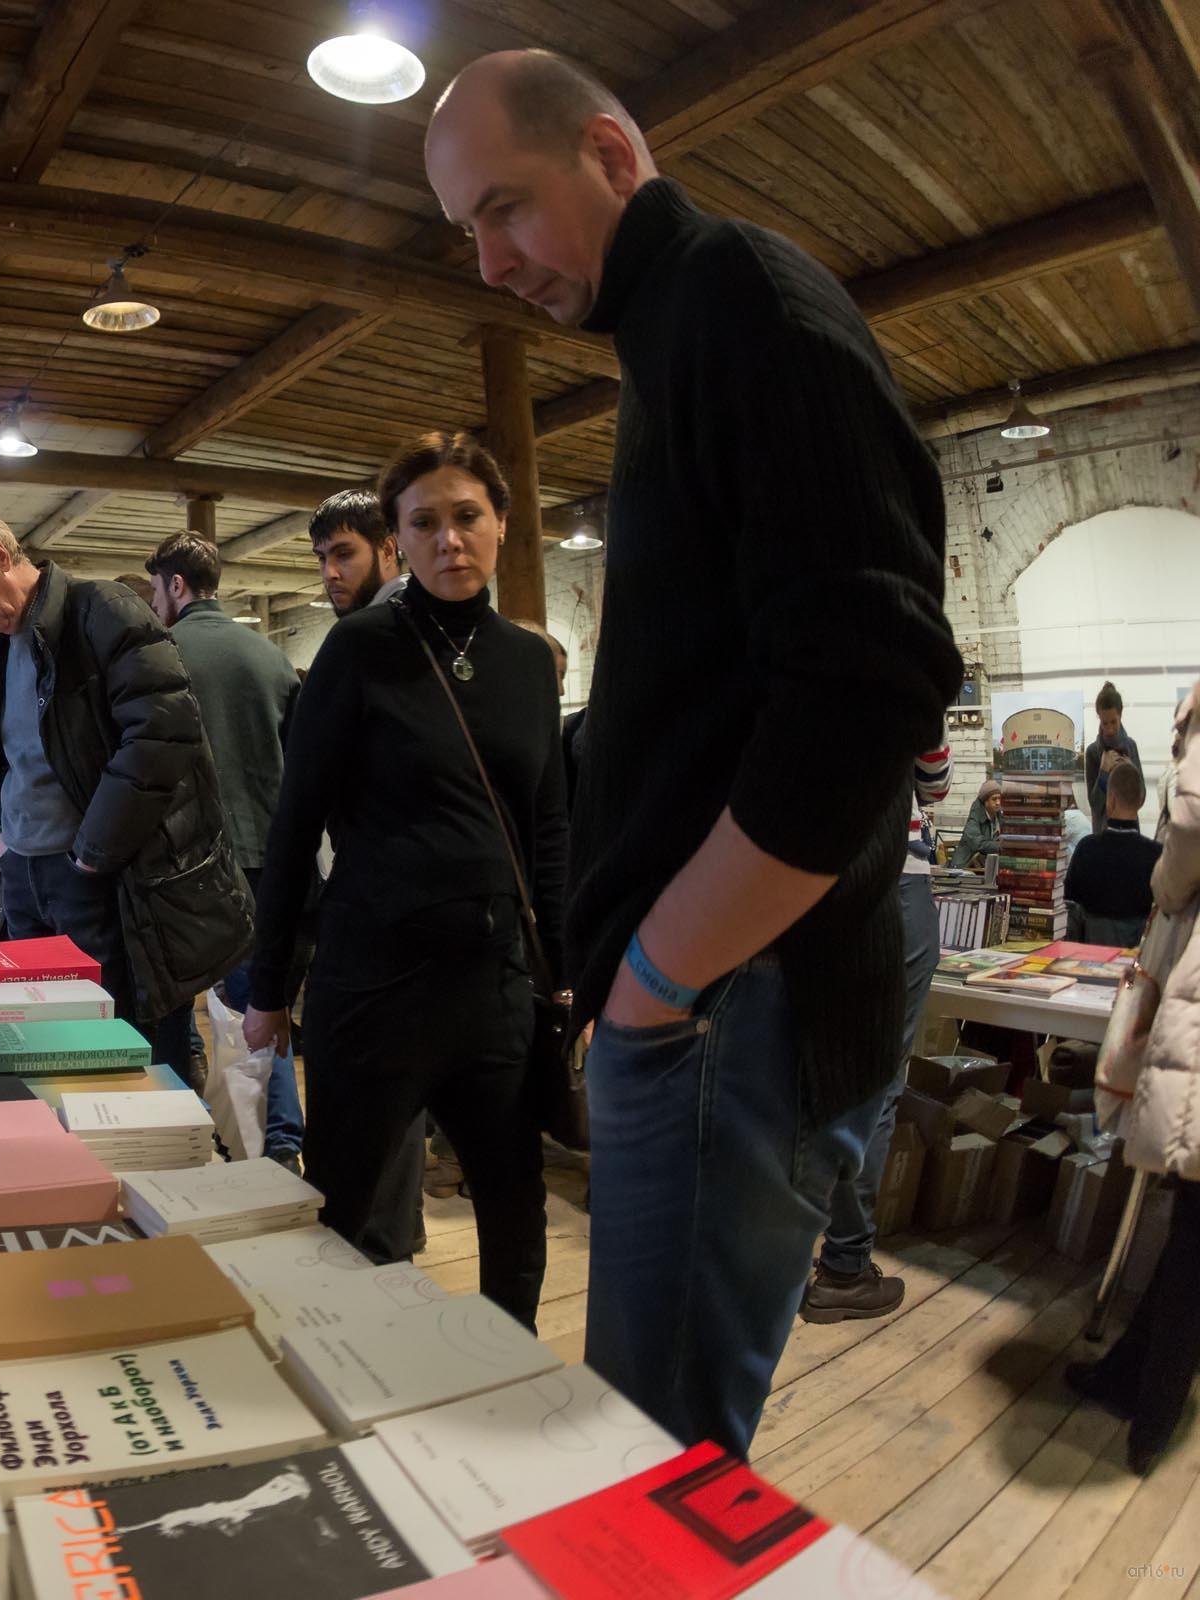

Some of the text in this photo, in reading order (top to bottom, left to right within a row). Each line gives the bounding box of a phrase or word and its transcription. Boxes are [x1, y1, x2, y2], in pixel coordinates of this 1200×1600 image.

[98, 1385, 122, 1398] Б
[111, 1353, 184, 1452] и наоборот)
[113, 1412, 138, 1425] А
[169, 1359, 223, 1431] Энди Уорхол
[26, 1420, 59, 1468] Энди
[46, 1390, 91, 1464] Уорхола
[127, 1429, 159, 1456] (от
[319, 1461, 407, 1570] ANDY WARHOL
